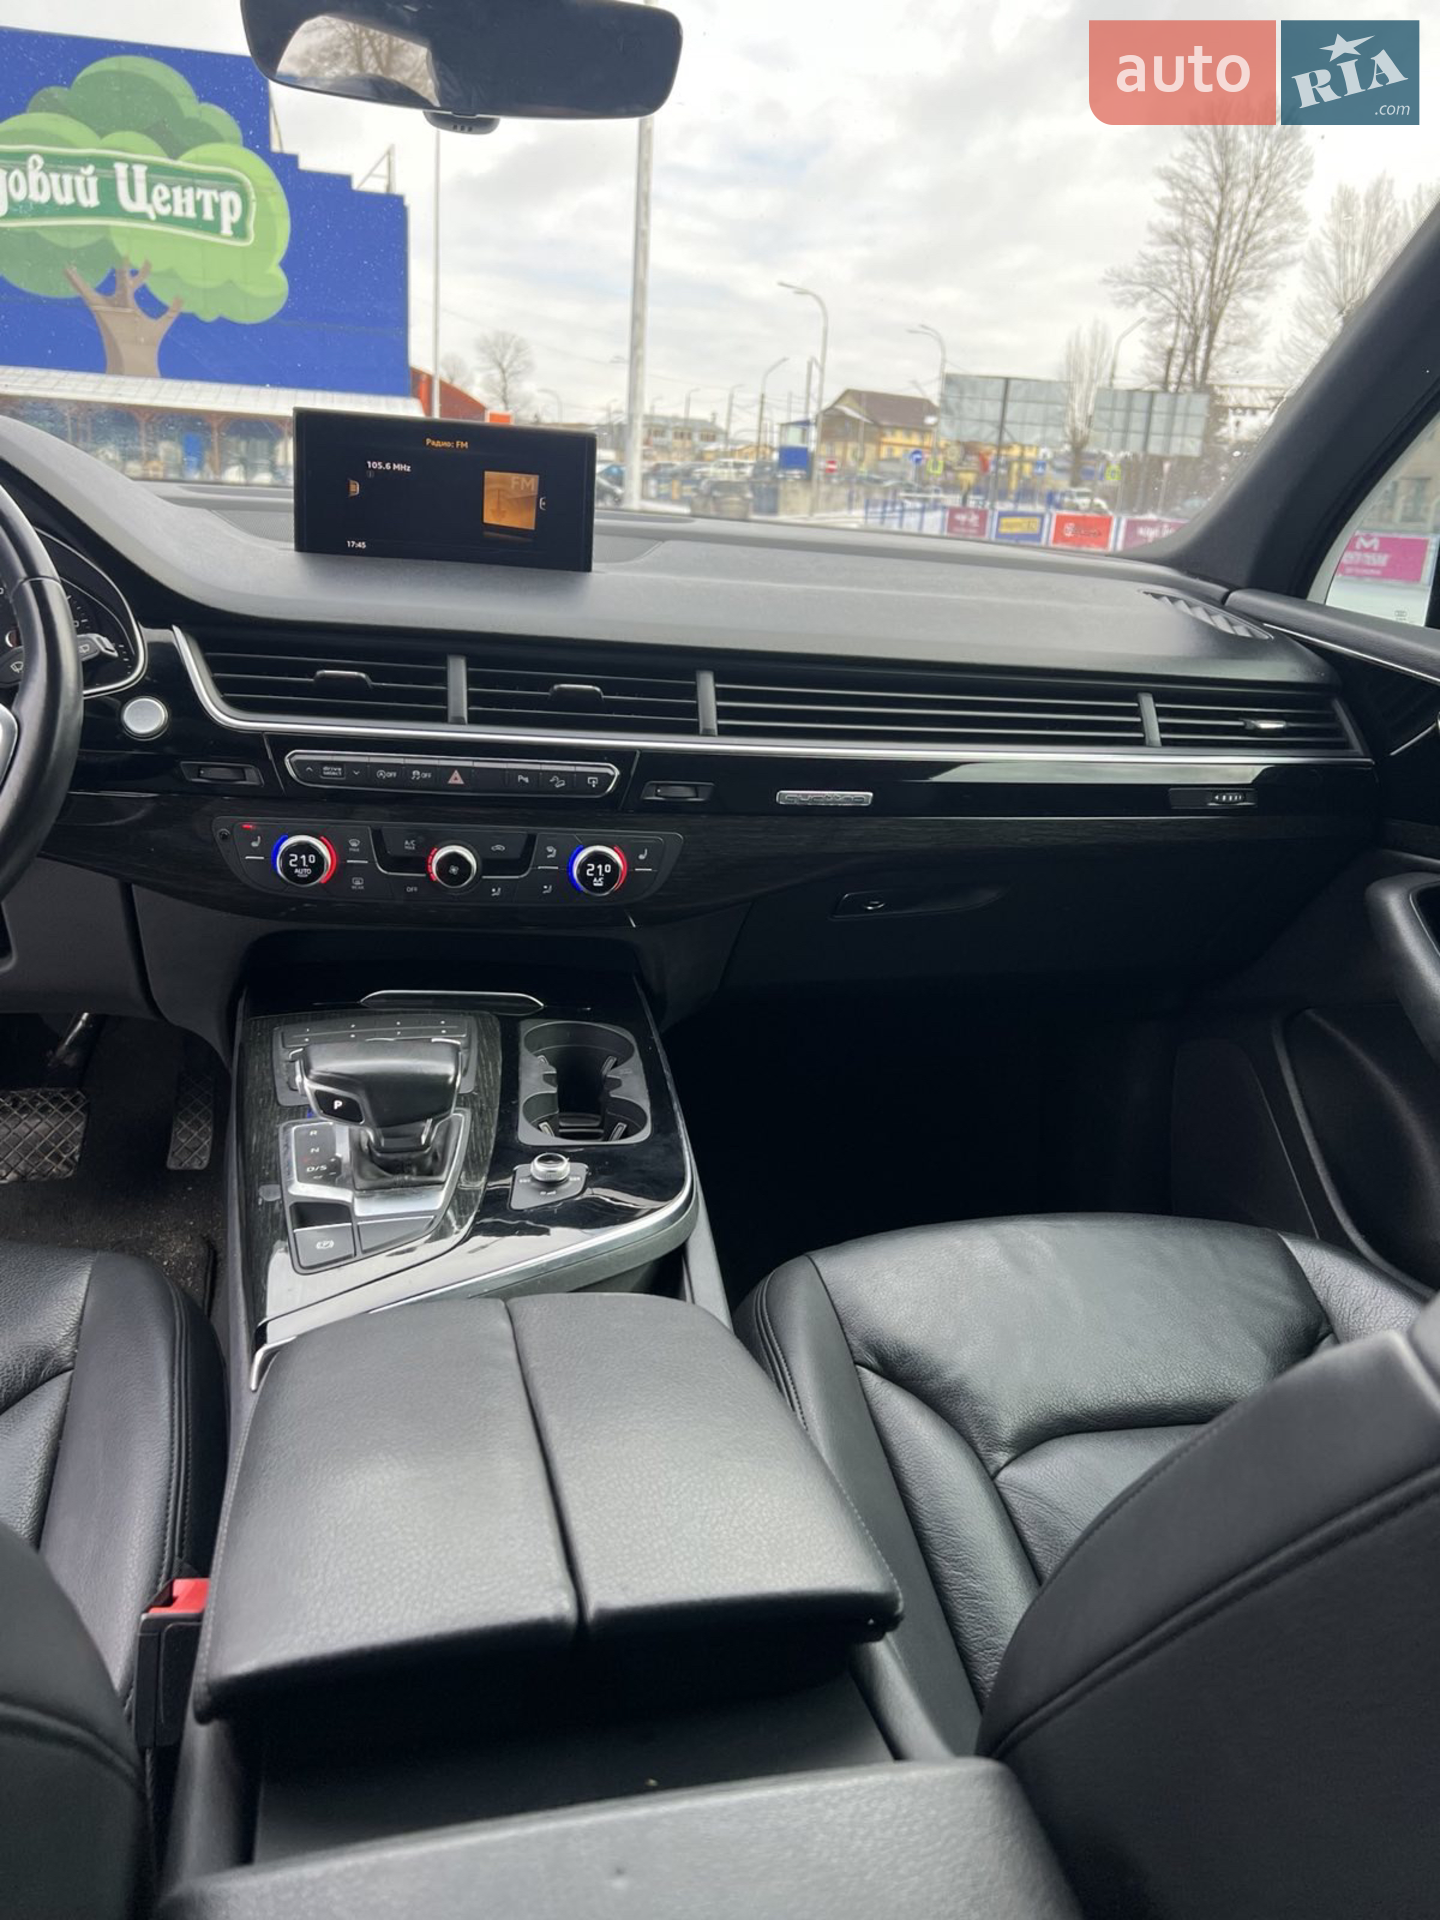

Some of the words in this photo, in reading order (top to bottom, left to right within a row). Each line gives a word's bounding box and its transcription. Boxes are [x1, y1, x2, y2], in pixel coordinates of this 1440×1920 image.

[114, 162, 243, 236] Центр
[425, 438, 455, 448] Радио:
[456, 441, 469, 449] FM
[366, 460, 392, 470] 105.6
[392, 463, 412, 472] MHz
[511, 477, 535, 491] FM
[346, 540, 367, 549] 17:45
[333, 1099, 343, 1110] P
